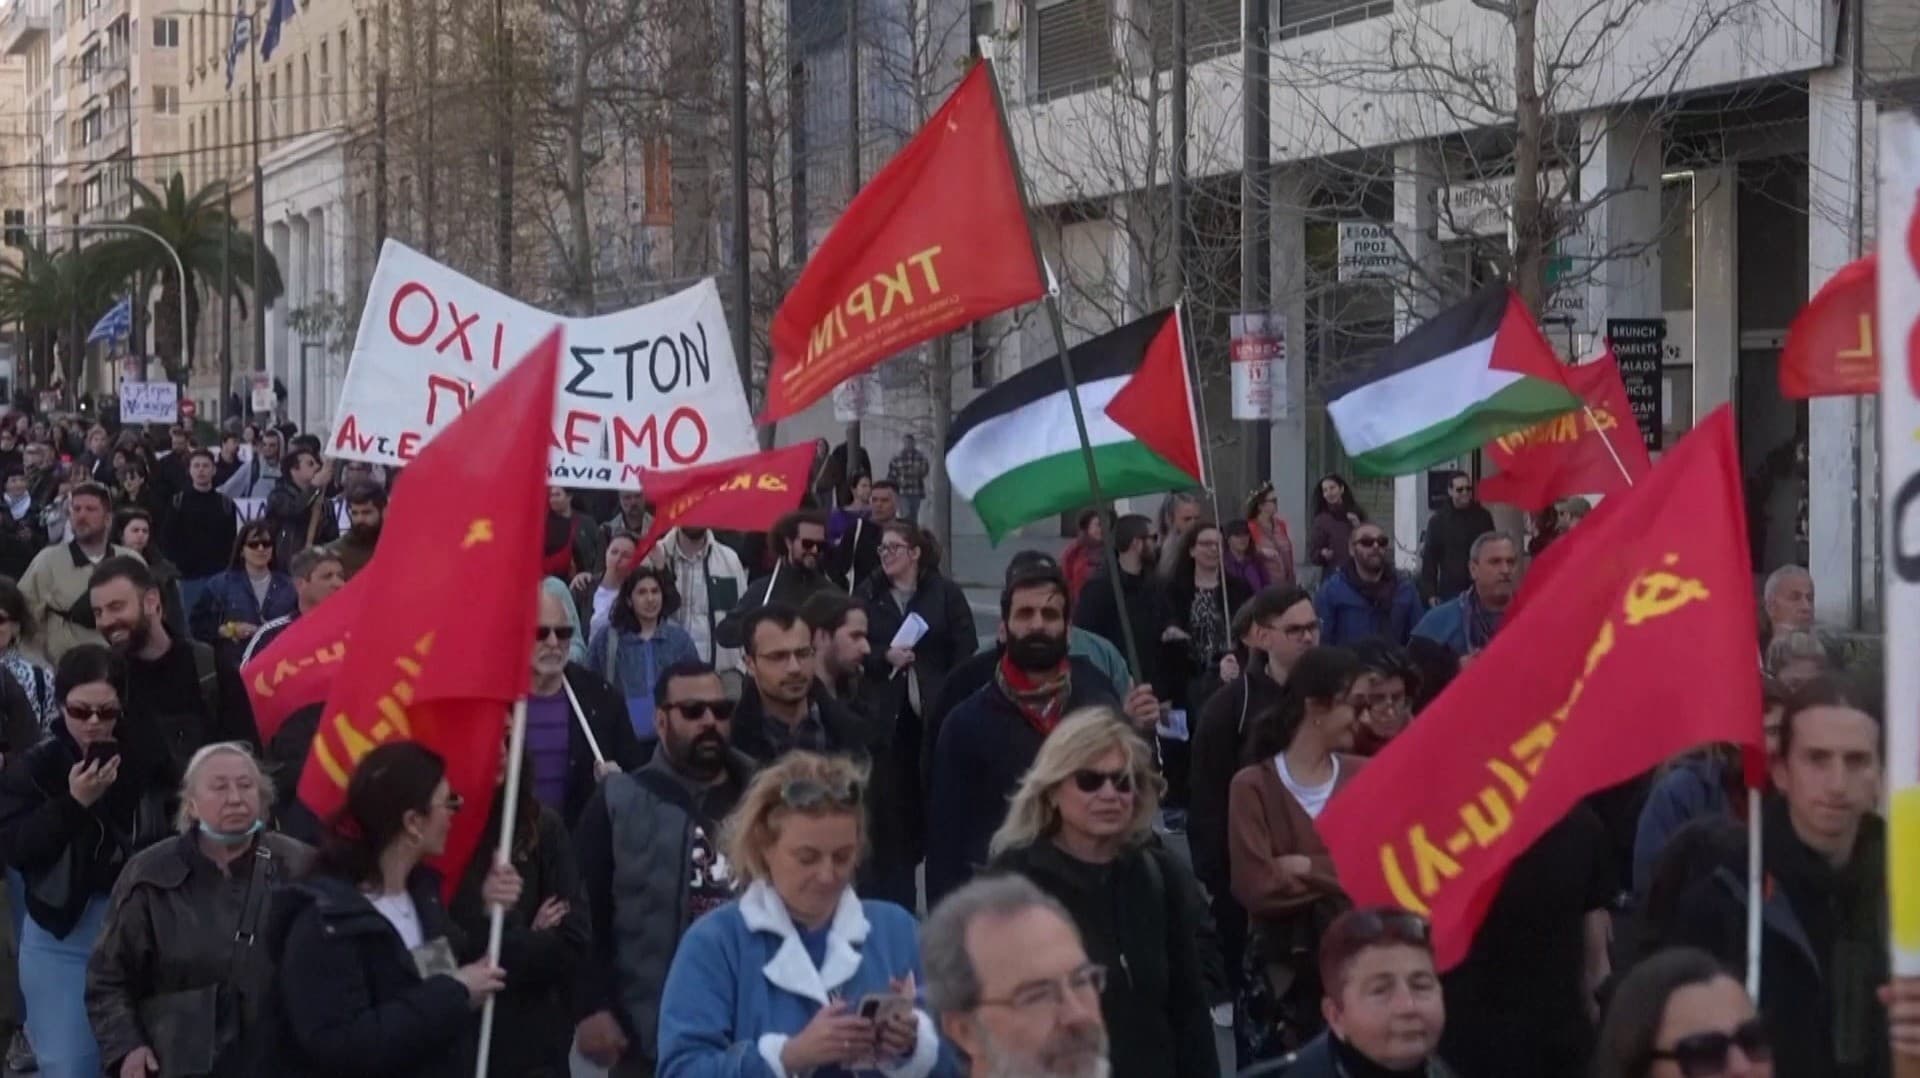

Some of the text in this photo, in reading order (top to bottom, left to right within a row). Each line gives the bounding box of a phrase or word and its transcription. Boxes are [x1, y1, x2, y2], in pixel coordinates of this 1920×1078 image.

[1354, 241, 1386, 254] ΠΡΟΣ
[1612, 326, 1657, 337] BRUNCH
[389, 281, 503, 371] ΟΧΙ
[564, 321, 710, 402] ΣΤΟΝ
[1611, 343, 1658, 355] OMELETS
[1617, 360, 1657, 371] ALADS
[1626, 385, 1654, 396] ICES
[1631, 401, 1656, 413] GAN
[428, 375, 708, 468] ΠΕΜΟ
